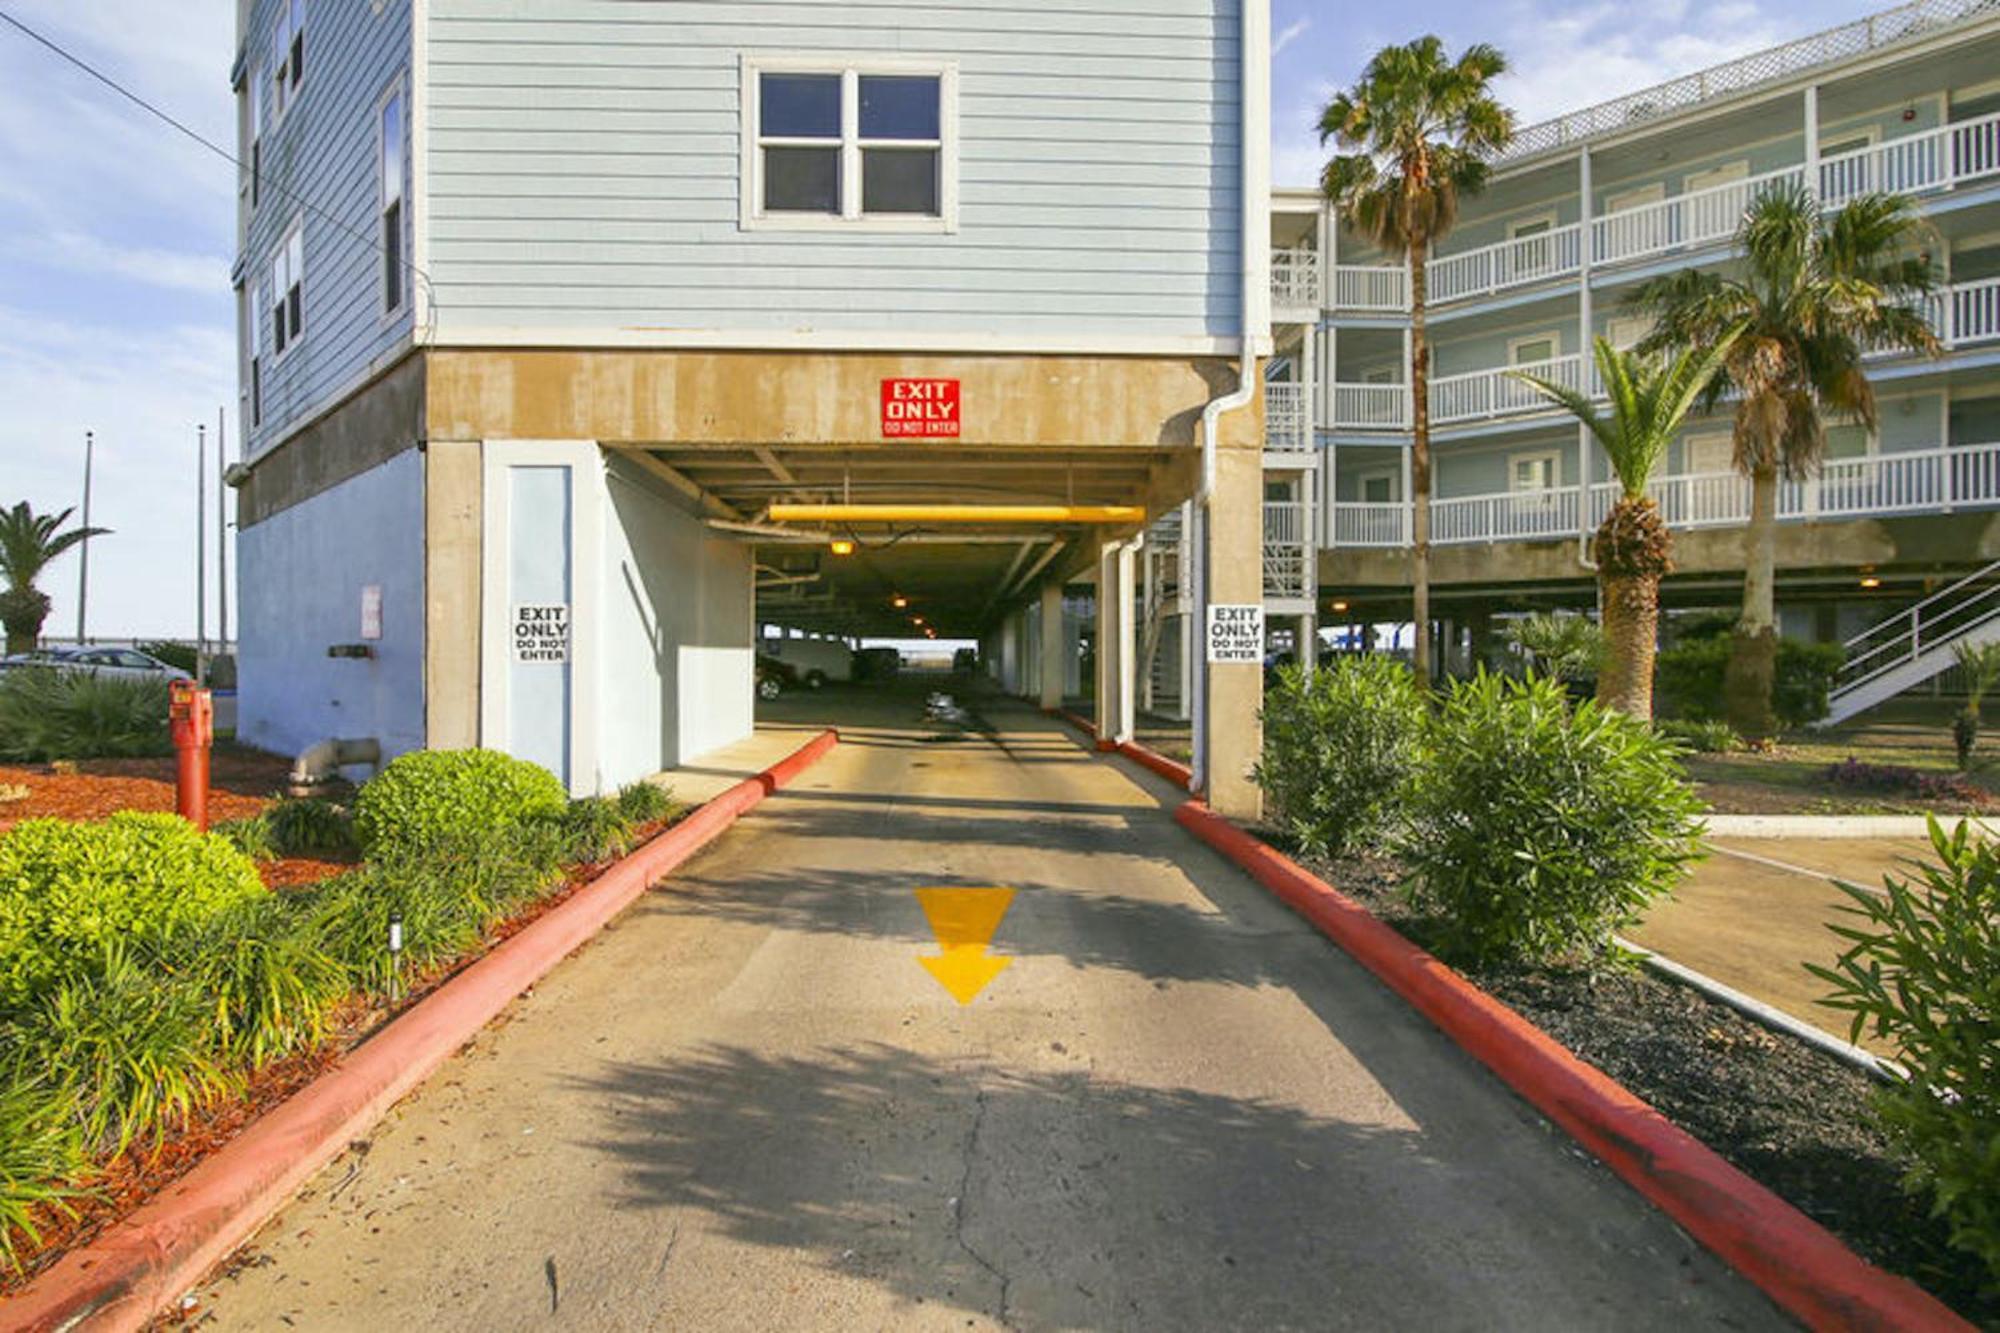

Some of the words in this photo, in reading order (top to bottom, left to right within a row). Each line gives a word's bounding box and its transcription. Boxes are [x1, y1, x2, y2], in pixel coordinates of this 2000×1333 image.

[893, 382, 949, 399] EXIT
[886, 401, 954, 419] ONLY
[884, 422, 900, 434] DO
[902, 422, 924, 434] NOT
[926, 422, 958, 434] ENTER
[520, 607, 564, 621] EXIT
[1215, 607, 1257, 621] EXIT
[515, 623, 568, 637] ONLY
[1212, 623, 1260, 637] ONLY
[517, 640, 535, 649] DO
[540, 640, 567, 649] NOT
[1212, 640, 1230, 649] DO
[1234, 640, 1259, 649] NOT
[520, 650, 563, 660] ENTER
[1215, 650, 1256, 659] ENTER
